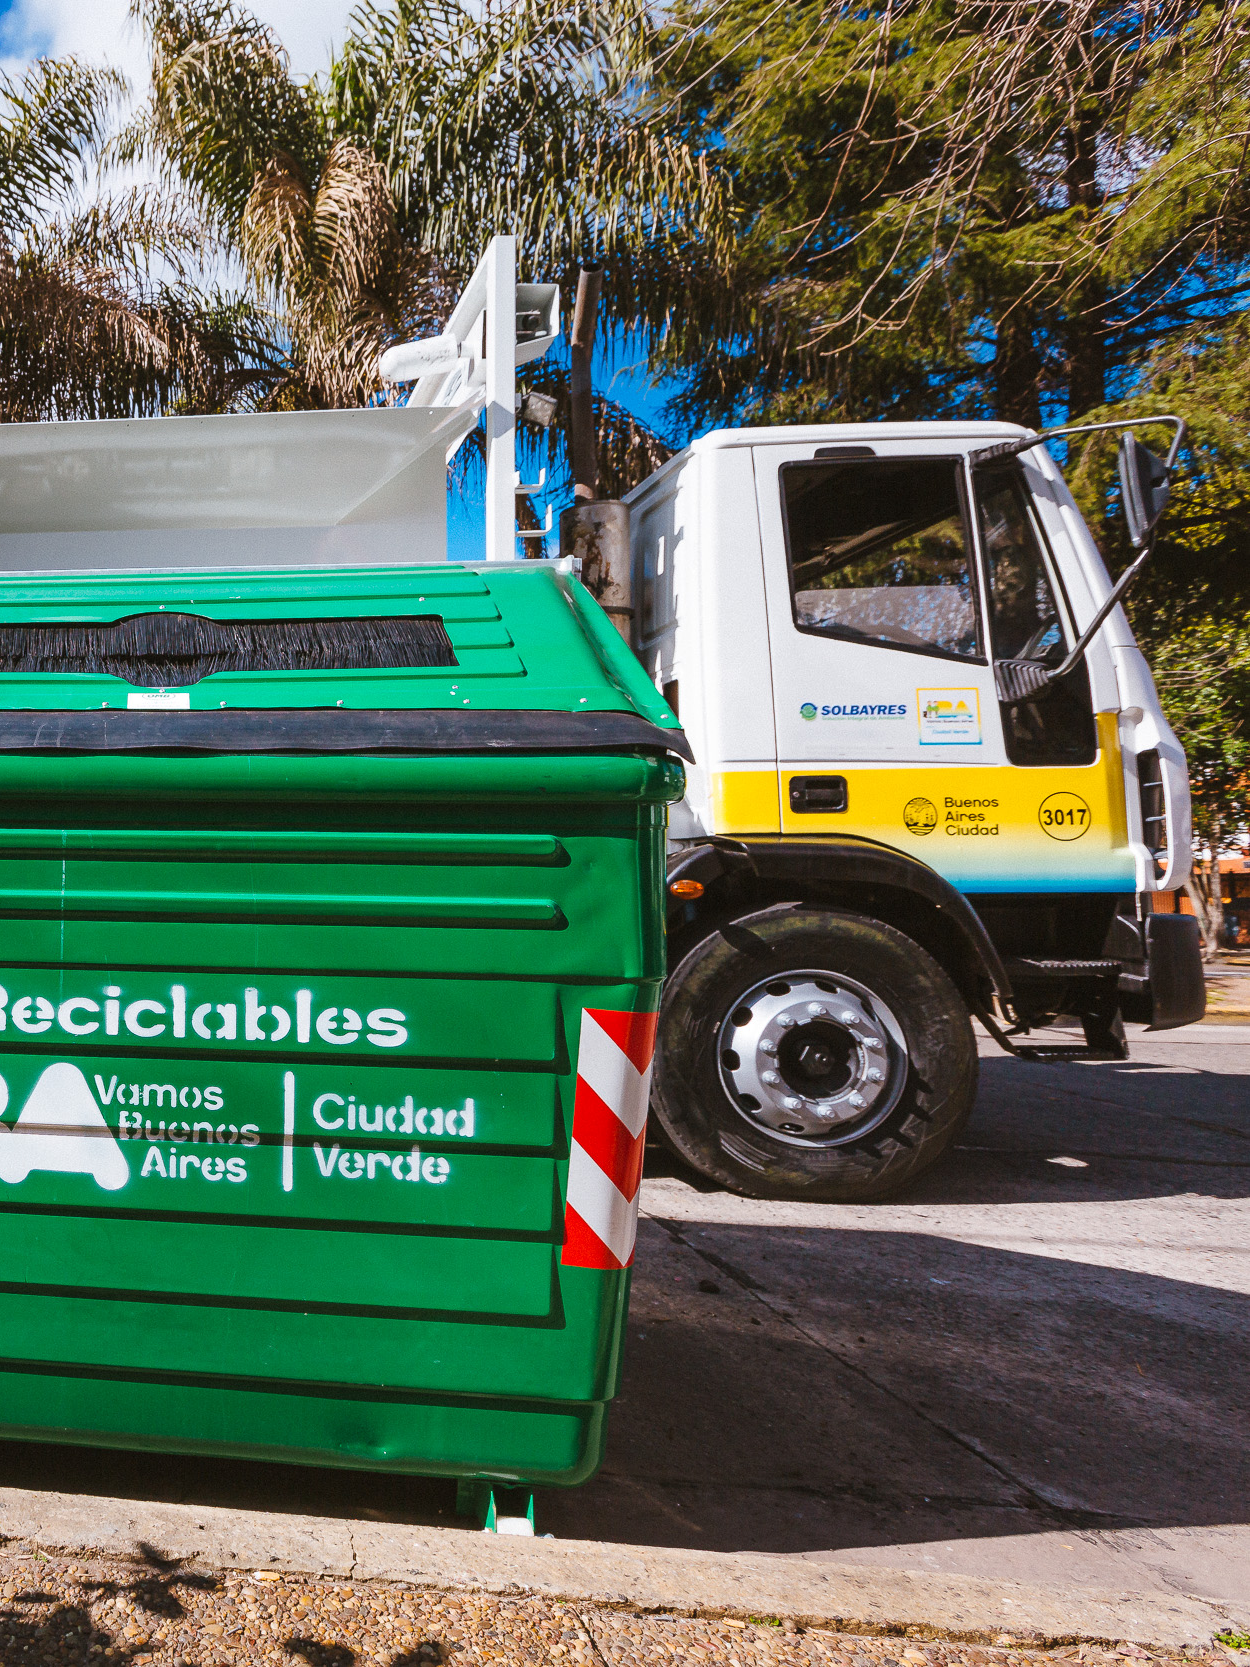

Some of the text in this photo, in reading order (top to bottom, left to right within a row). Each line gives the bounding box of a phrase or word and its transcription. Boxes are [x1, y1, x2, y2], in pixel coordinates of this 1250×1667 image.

[821, 705, 907, 716] SOLBAYRES
[944, 797, 999, 808] Buenos
[945, 811, 985, 822] Aires
[1043, 809, 1087, 826] 3017
[945, 825, 999, 836] Ciudad
[94, 1074, 224, 1111] Vamos
[116, 1109, 262, 1148] Buenos
[312, 1093, 476, 1139] Ciudad
[140, 1146, 249, 1184] Aires
[313, 1141, 451, 1185] Verde
